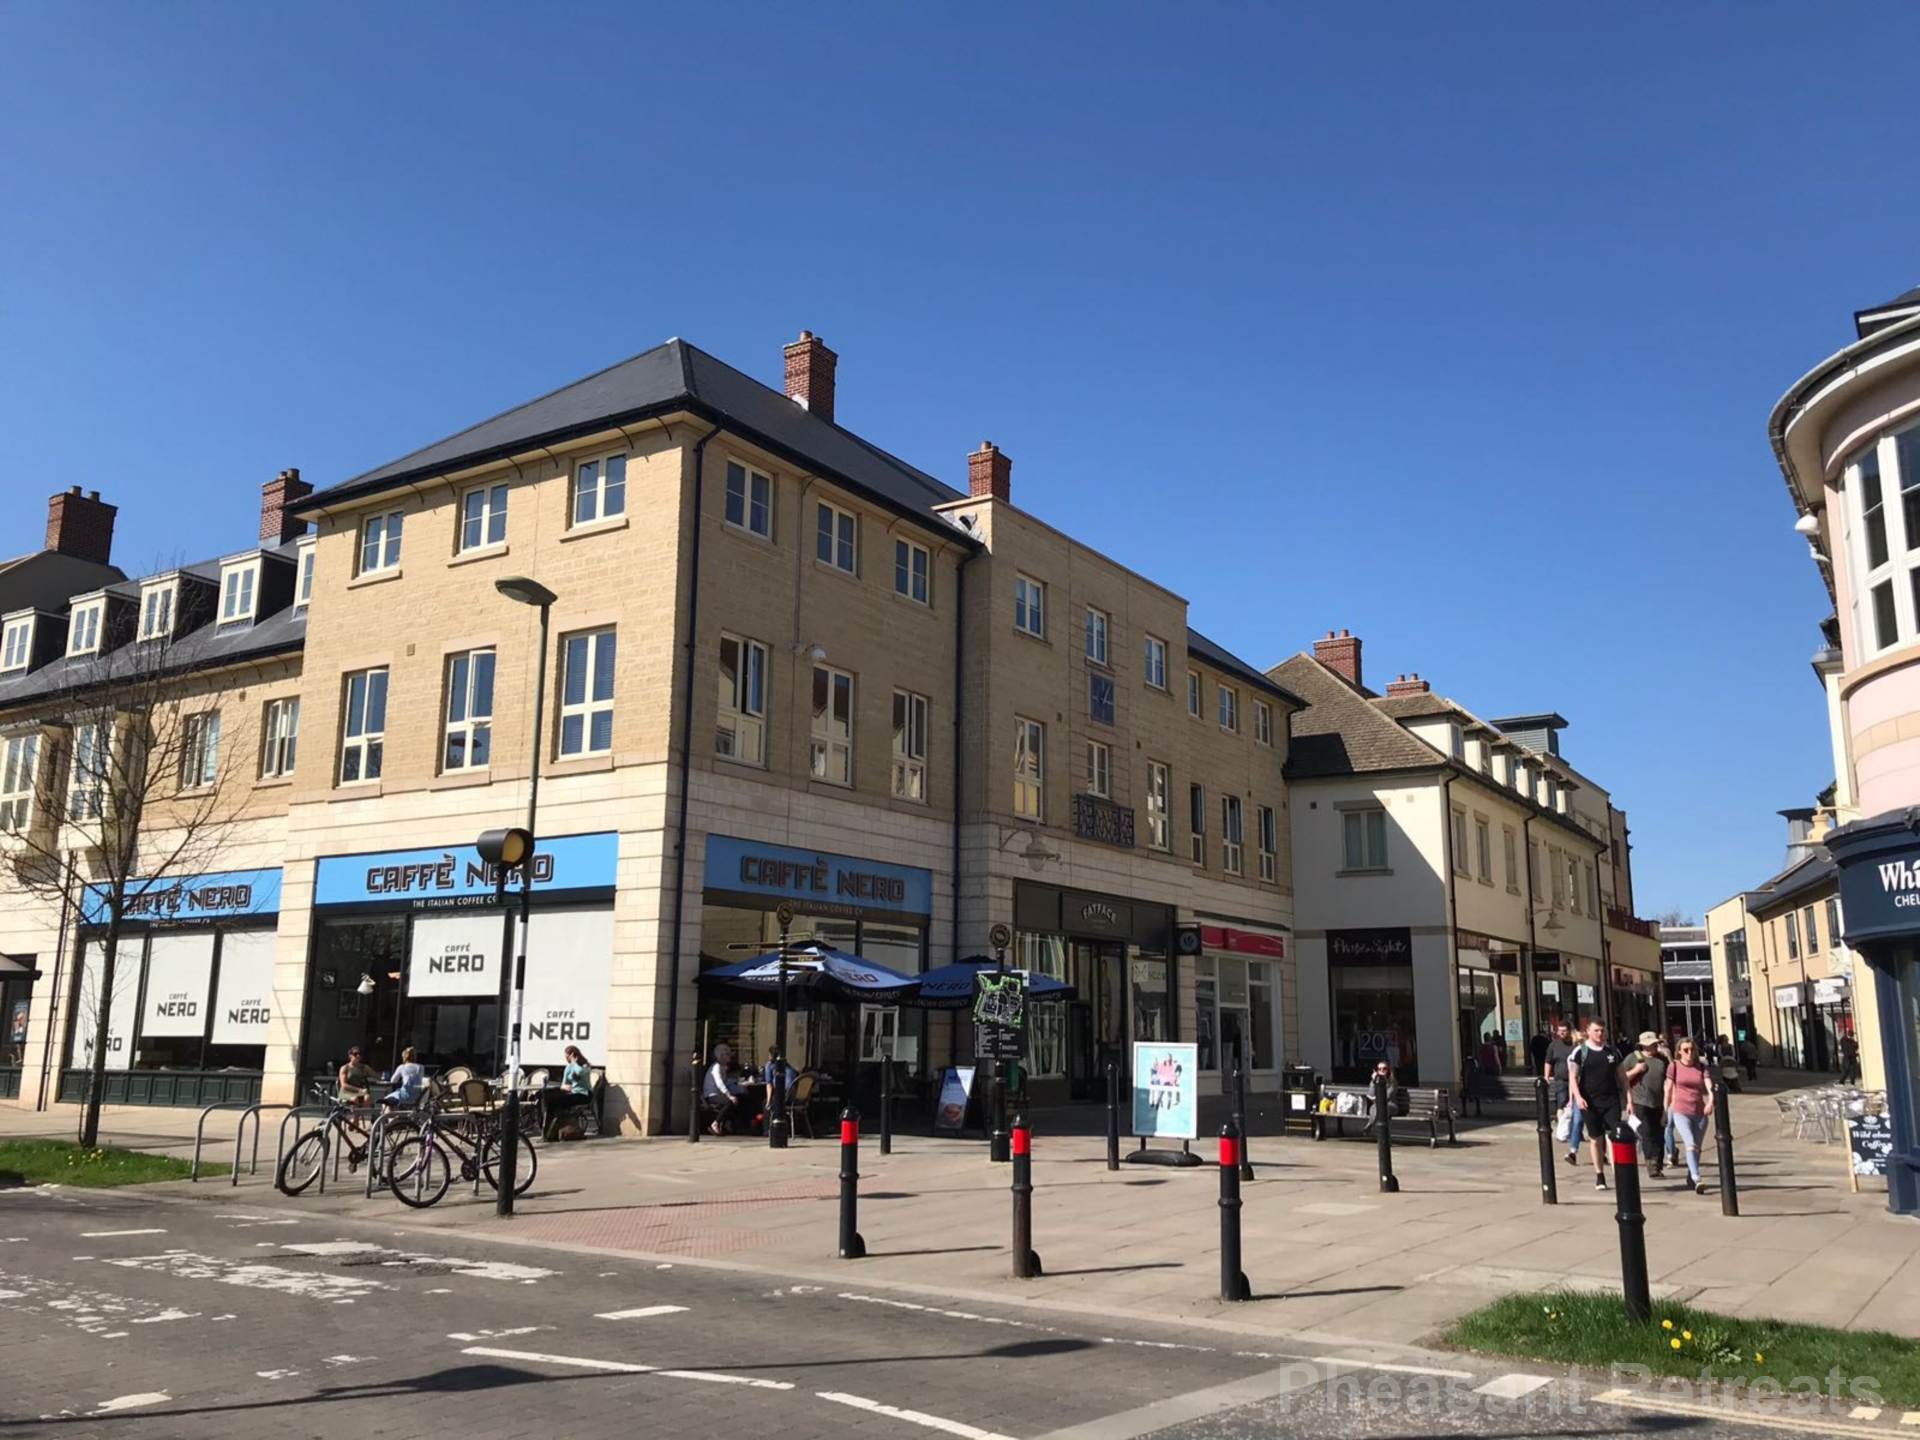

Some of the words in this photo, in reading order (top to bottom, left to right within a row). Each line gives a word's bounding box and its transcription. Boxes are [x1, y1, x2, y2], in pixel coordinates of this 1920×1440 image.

[837, 868, 905, 901] NERO
[188, 885, 252, 912] NERO
[413, 900, 425, 908] THE
[427, 898, 454, 907] ITALIAN
[457, 896, 484, 905] COFFEE
[429, 954, 484, 974] NERO
[157, 1002, 197, 1017] NERO
[228, 1008, 271, 1024] NERO
[529, 1022, 590, 1040] NERO
[84, 1037, 122, 1051] NRO
